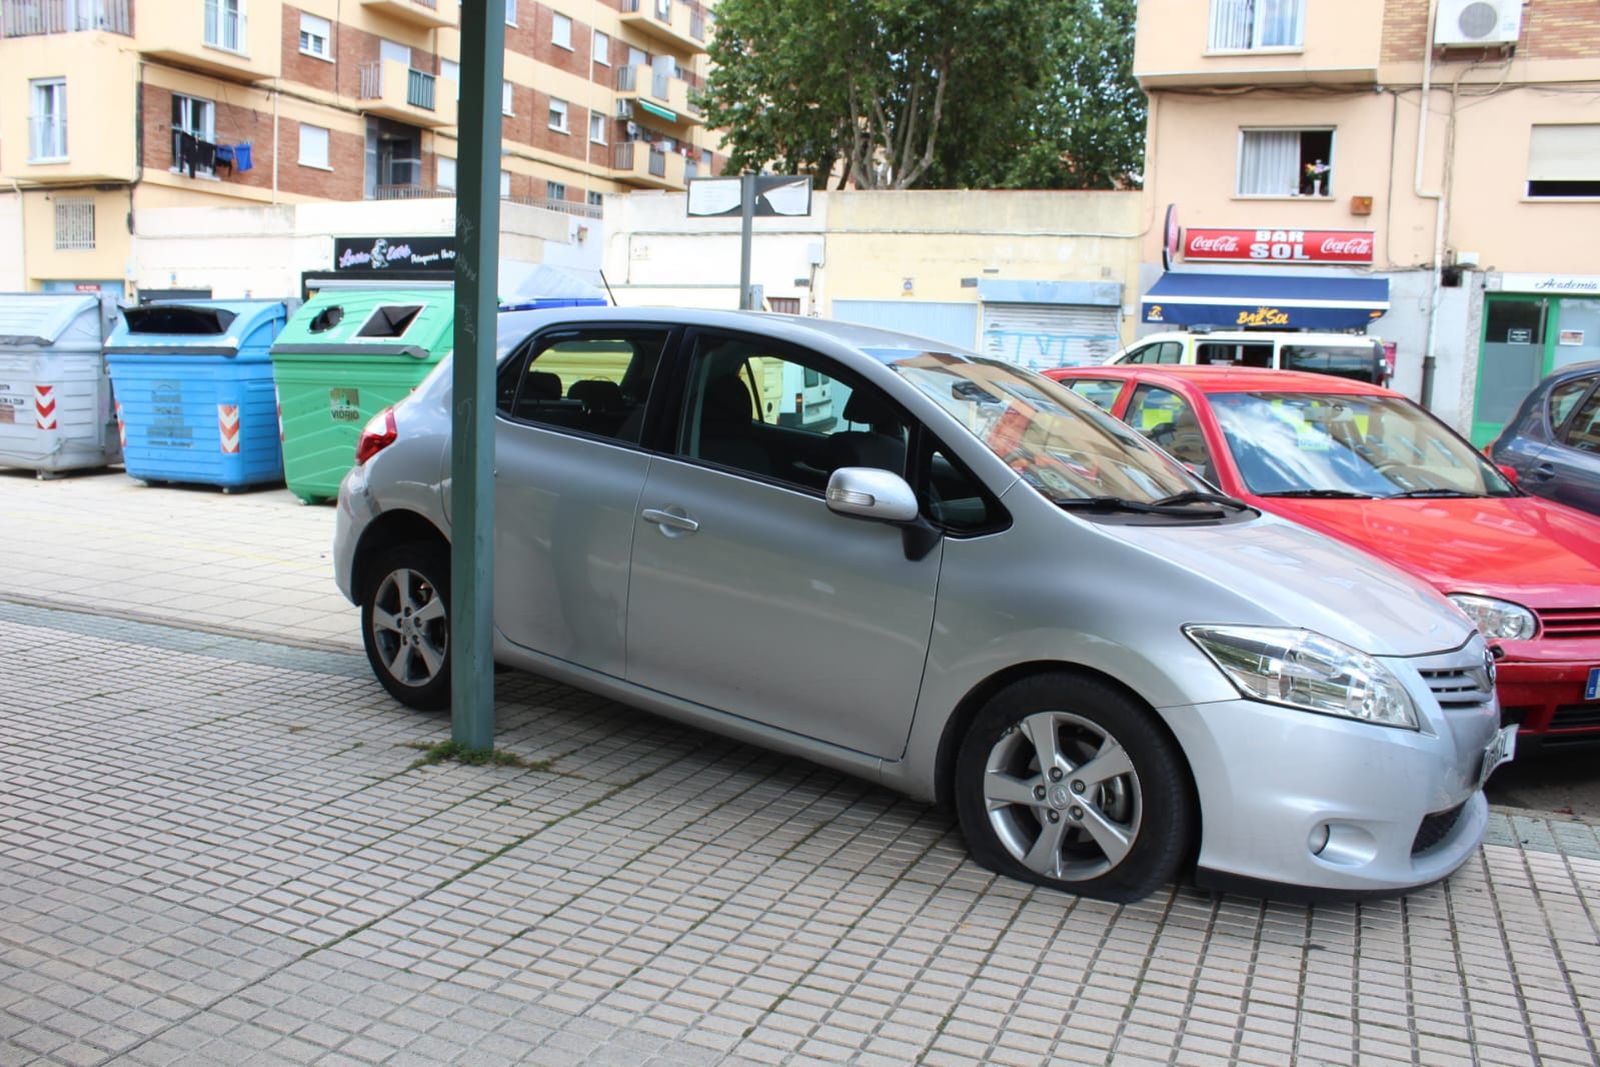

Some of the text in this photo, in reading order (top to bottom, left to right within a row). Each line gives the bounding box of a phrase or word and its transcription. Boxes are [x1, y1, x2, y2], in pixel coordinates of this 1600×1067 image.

[1255, 230, 1305, 243] BAR
[1191, 237, 1239, 252] Coca-Cola
[1250, 243, 1311, 259] SOL
[1321, 239, 1371, 254] Coca-Cola
[1535, 278, 1599, 290] Academia
